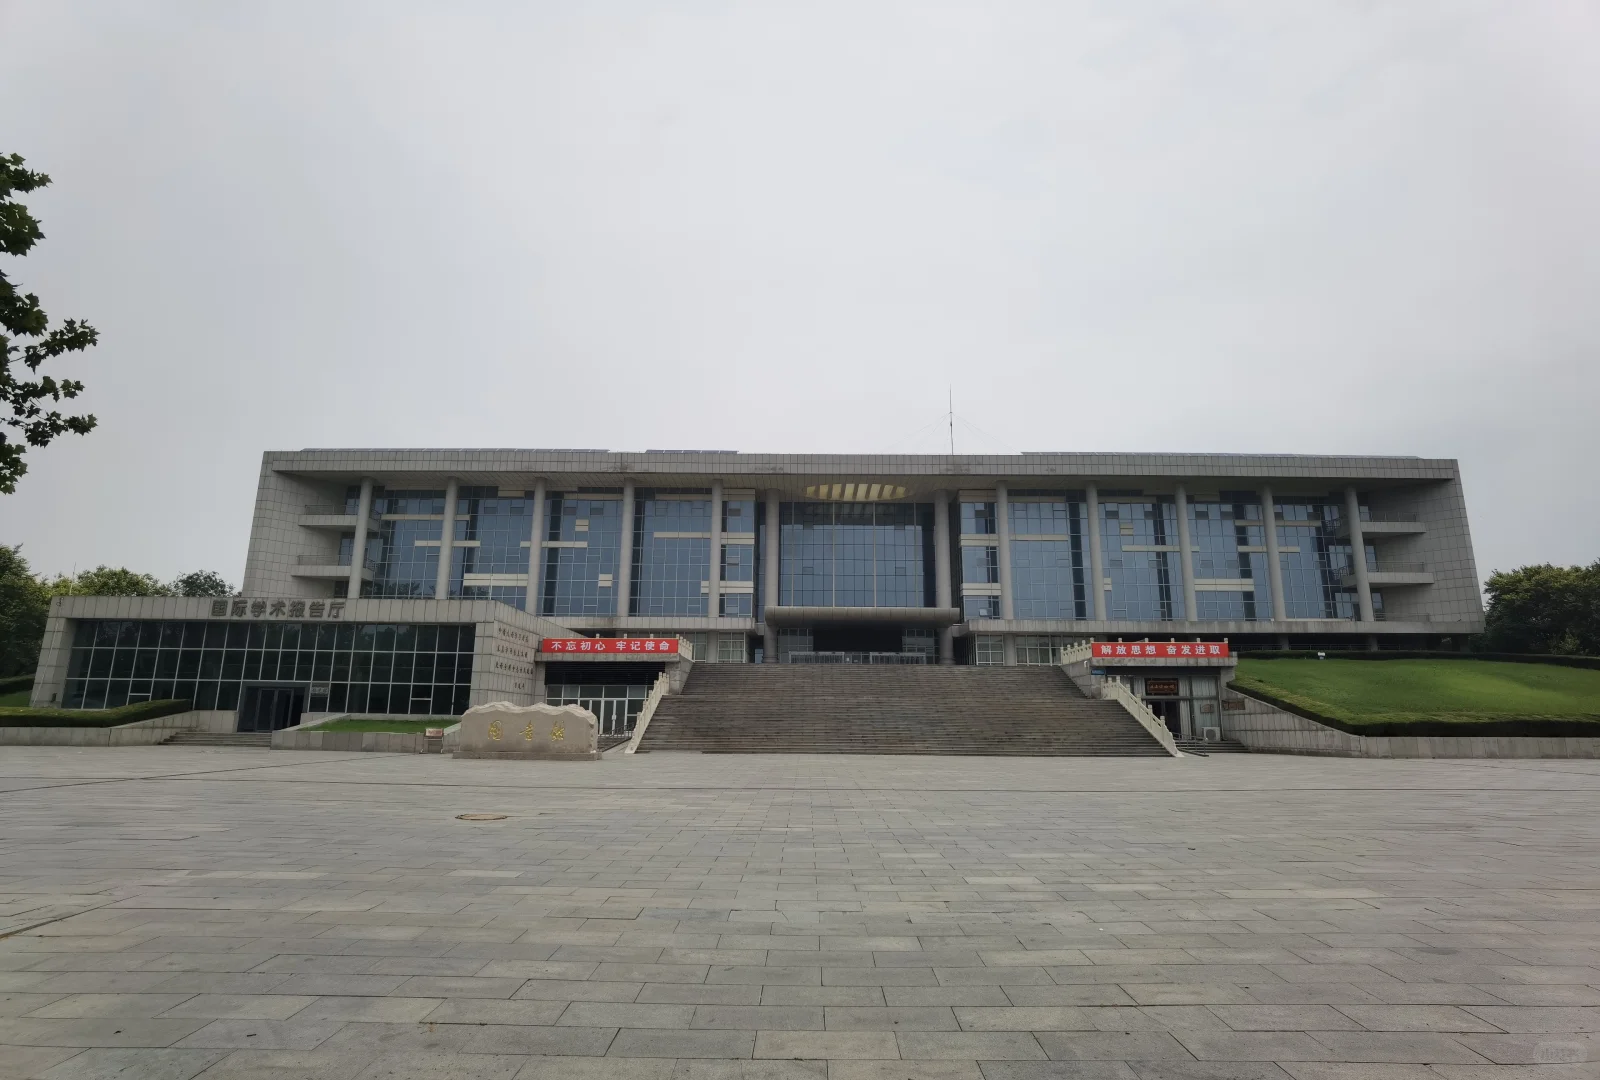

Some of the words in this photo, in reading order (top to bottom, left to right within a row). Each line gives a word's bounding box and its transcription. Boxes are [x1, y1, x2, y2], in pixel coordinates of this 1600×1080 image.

[210, 599, 346, 618] 国际学术报告厅
[551, 640, 606, 651] 不忘初心
[615, 640, 670, 651] 牢记使命
[1101, 645, 1157, 655] 解放思想
[1166, 645, 1221, 655] 奋发进取
